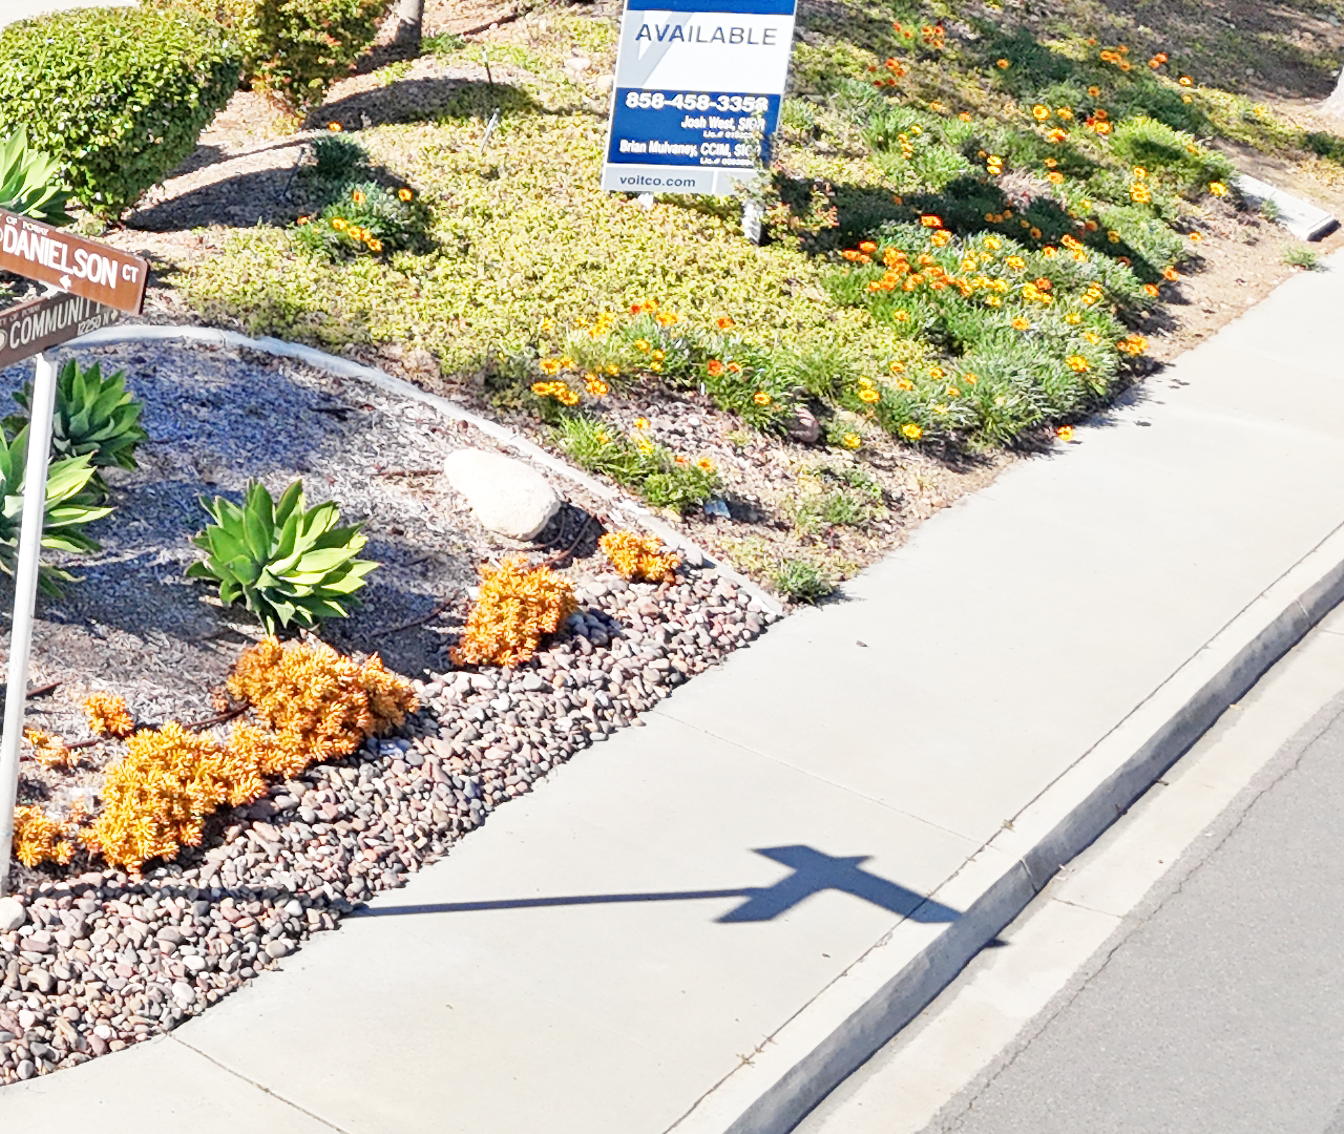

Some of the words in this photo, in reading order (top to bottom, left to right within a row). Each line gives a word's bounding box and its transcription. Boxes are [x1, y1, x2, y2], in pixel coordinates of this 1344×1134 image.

[634, 23, 778, 46] AVAILABLE
[681, 115, 708, 129] Josh
[619, 139, 647, 153] Brian
[619, 174, 696, 188] voitco.com
[2, 224, 119, 289] DANIELSON
[121, 263, 140, 284] CT
